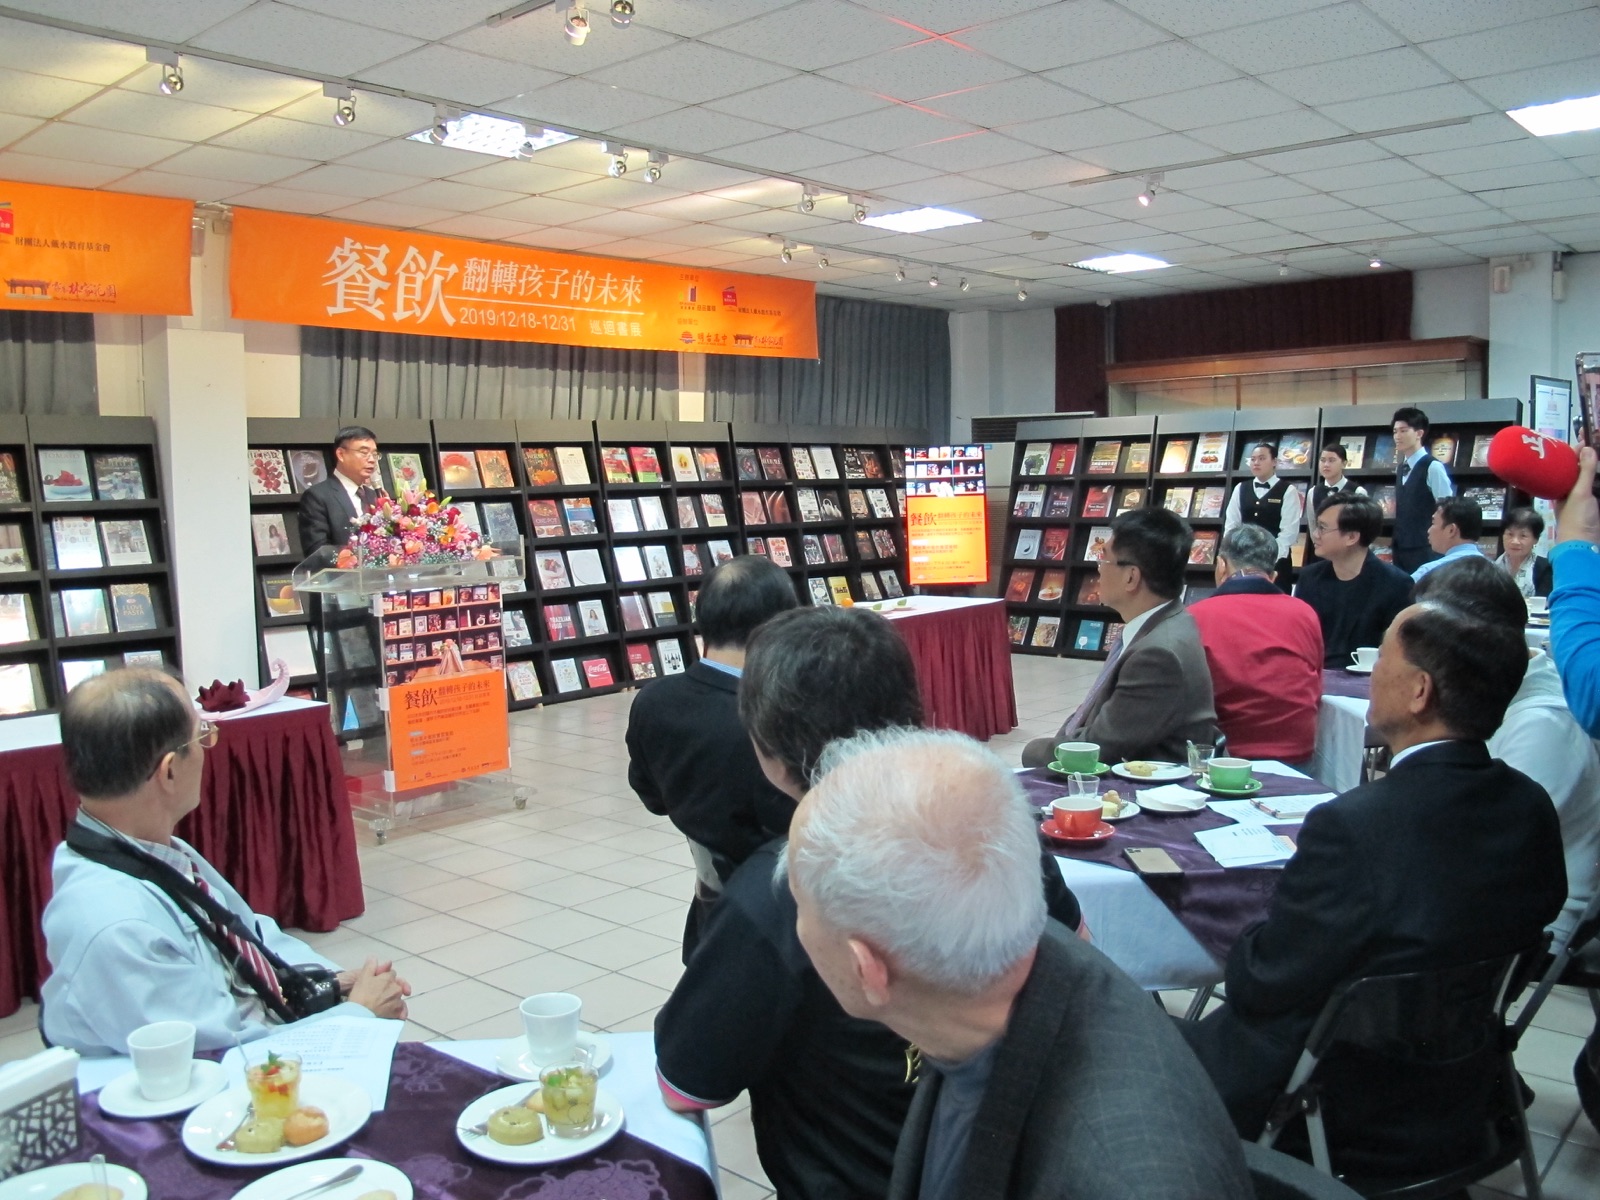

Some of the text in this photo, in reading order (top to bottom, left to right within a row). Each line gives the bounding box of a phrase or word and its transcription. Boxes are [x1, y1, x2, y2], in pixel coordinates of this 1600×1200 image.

[322, 236, 459, 327] 餐飲
[461, 256, 644, 307] 翻轉孩子的未來
[459, 306, 577, 332] 2019/12/18-12/31
[911, 512, 937, 526] 餐飲
[405, 687, 438, 710] 餐飲
